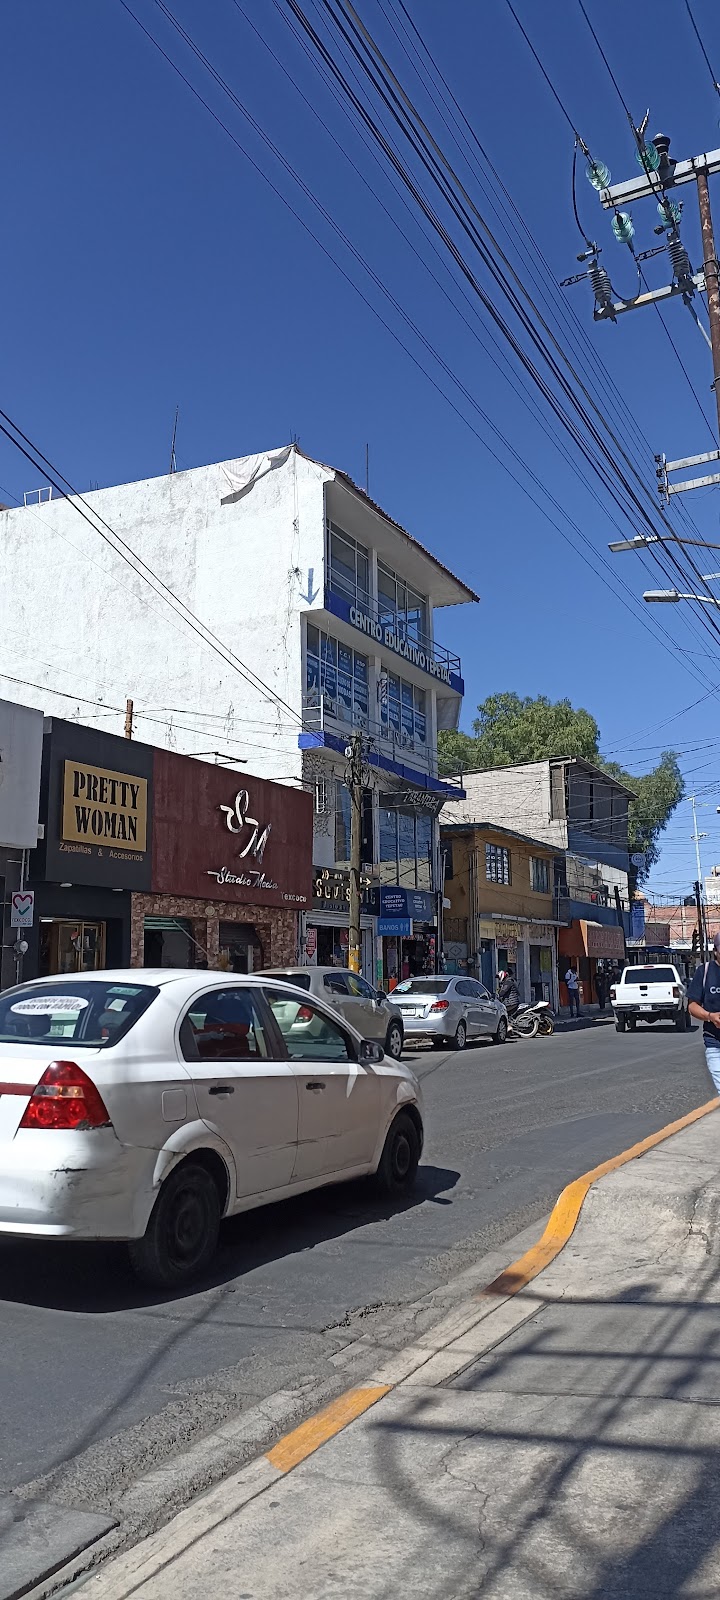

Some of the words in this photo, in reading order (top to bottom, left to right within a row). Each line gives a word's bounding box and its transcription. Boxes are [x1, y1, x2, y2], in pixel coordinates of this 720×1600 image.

[349, 606, 383, 641] CENTRO
[384, 628, 427, 668] EDUCATIVO
[73, 770, 140, 810] PRETTY
[74, 805, 138, 842] WOMAN
[59, 842, 92, 855] Zapatillas
[97, 848, 104, 857] &
[109, 849, 144, 862] Accesorios
[205, 866, 252, 886] Studio
[249, 870, 279, 889] Moda
